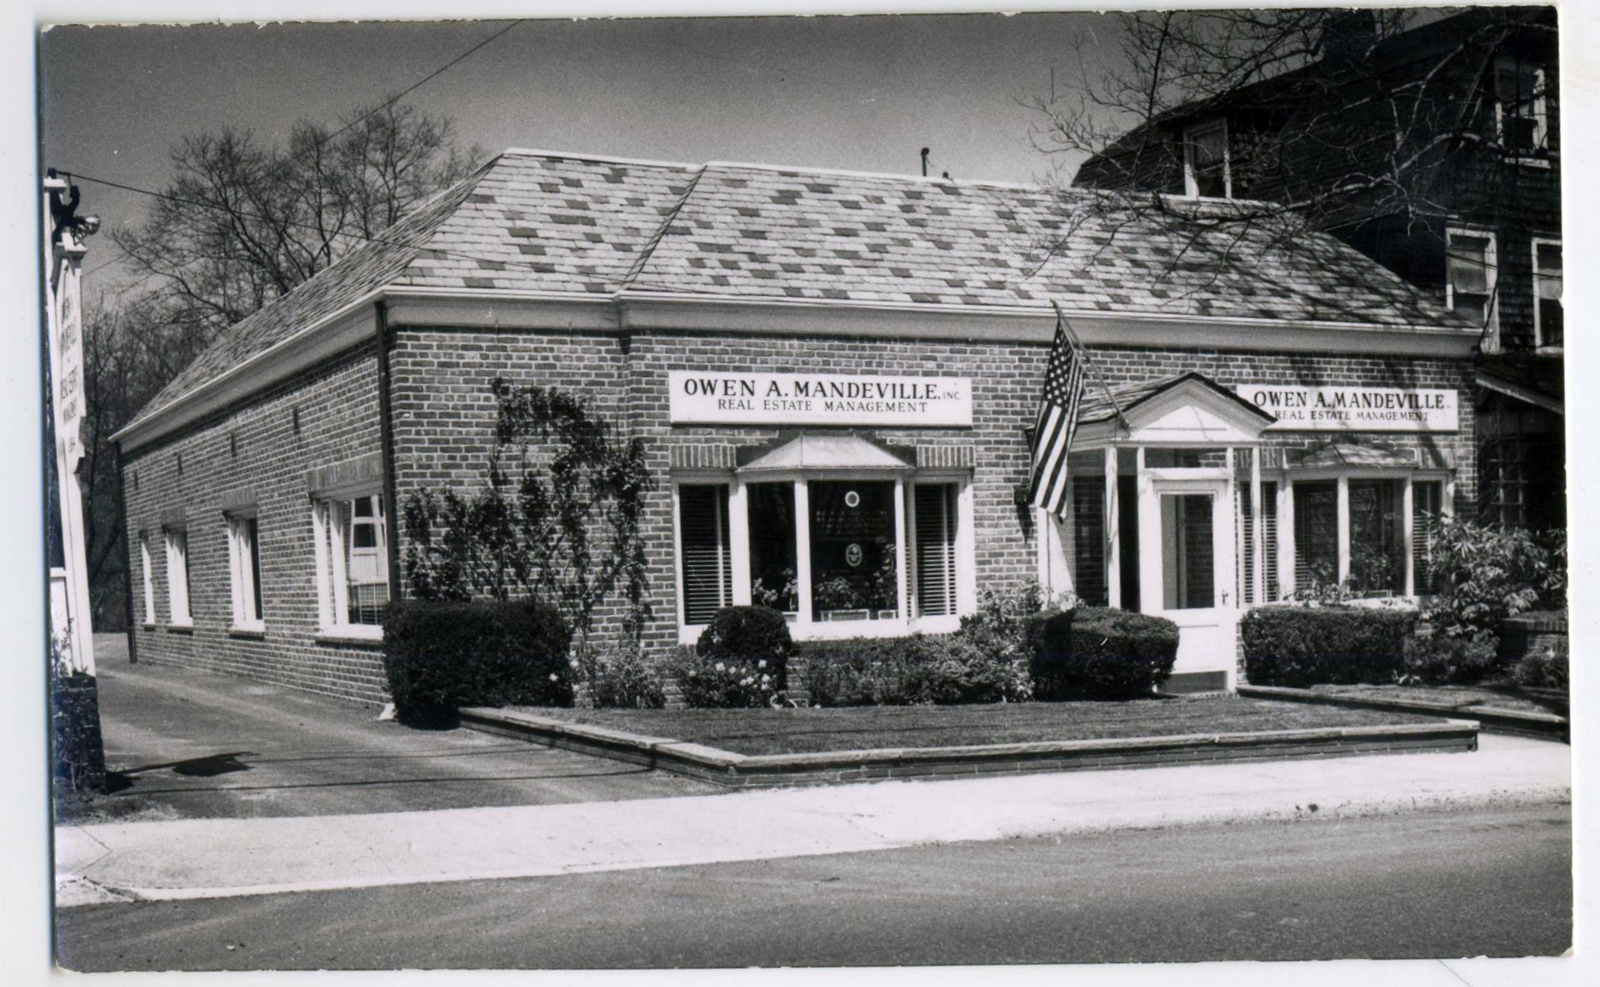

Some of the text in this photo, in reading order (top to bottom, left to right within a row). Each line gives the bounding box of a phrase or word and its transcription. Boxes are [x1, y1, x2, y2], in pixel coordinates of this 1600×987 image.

[684, 378, 757, 398] OWEN
[718, 399, 928, 413] REAL ESTATE MANAGEMENT
[1254, 390, 1308, 408] OWEN
[1275, 410, 1429, 422] REAL ESTATE MANAGEMENT
